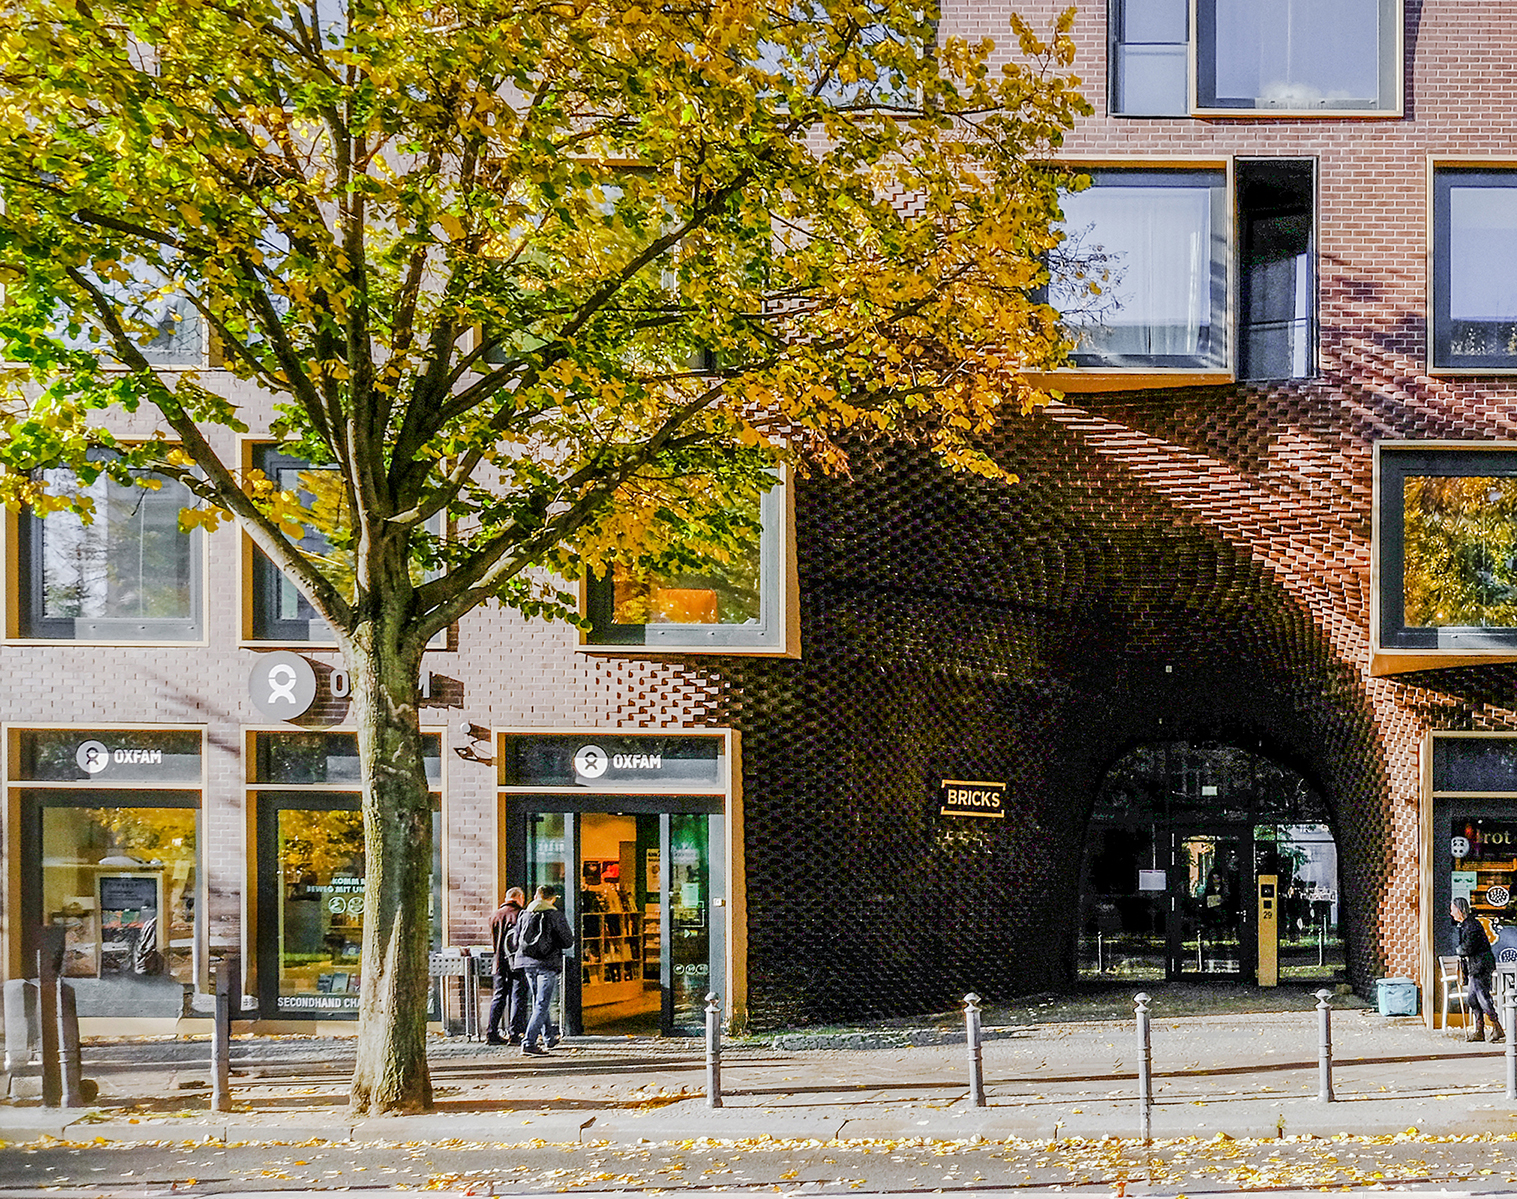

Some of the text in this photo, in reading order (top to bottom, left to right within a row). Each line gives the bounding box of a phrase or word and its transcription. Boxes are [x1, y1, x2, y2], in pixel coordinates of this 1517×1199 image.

[113, 749, 162, 764] OXFAM
[612, 753, 662, 769] OXFAM
[947, 789, 1000, 808] BRICKS
[1263, 911, 1272, 919] 29
[277, 997, 341, 1008] SECONDHAND
